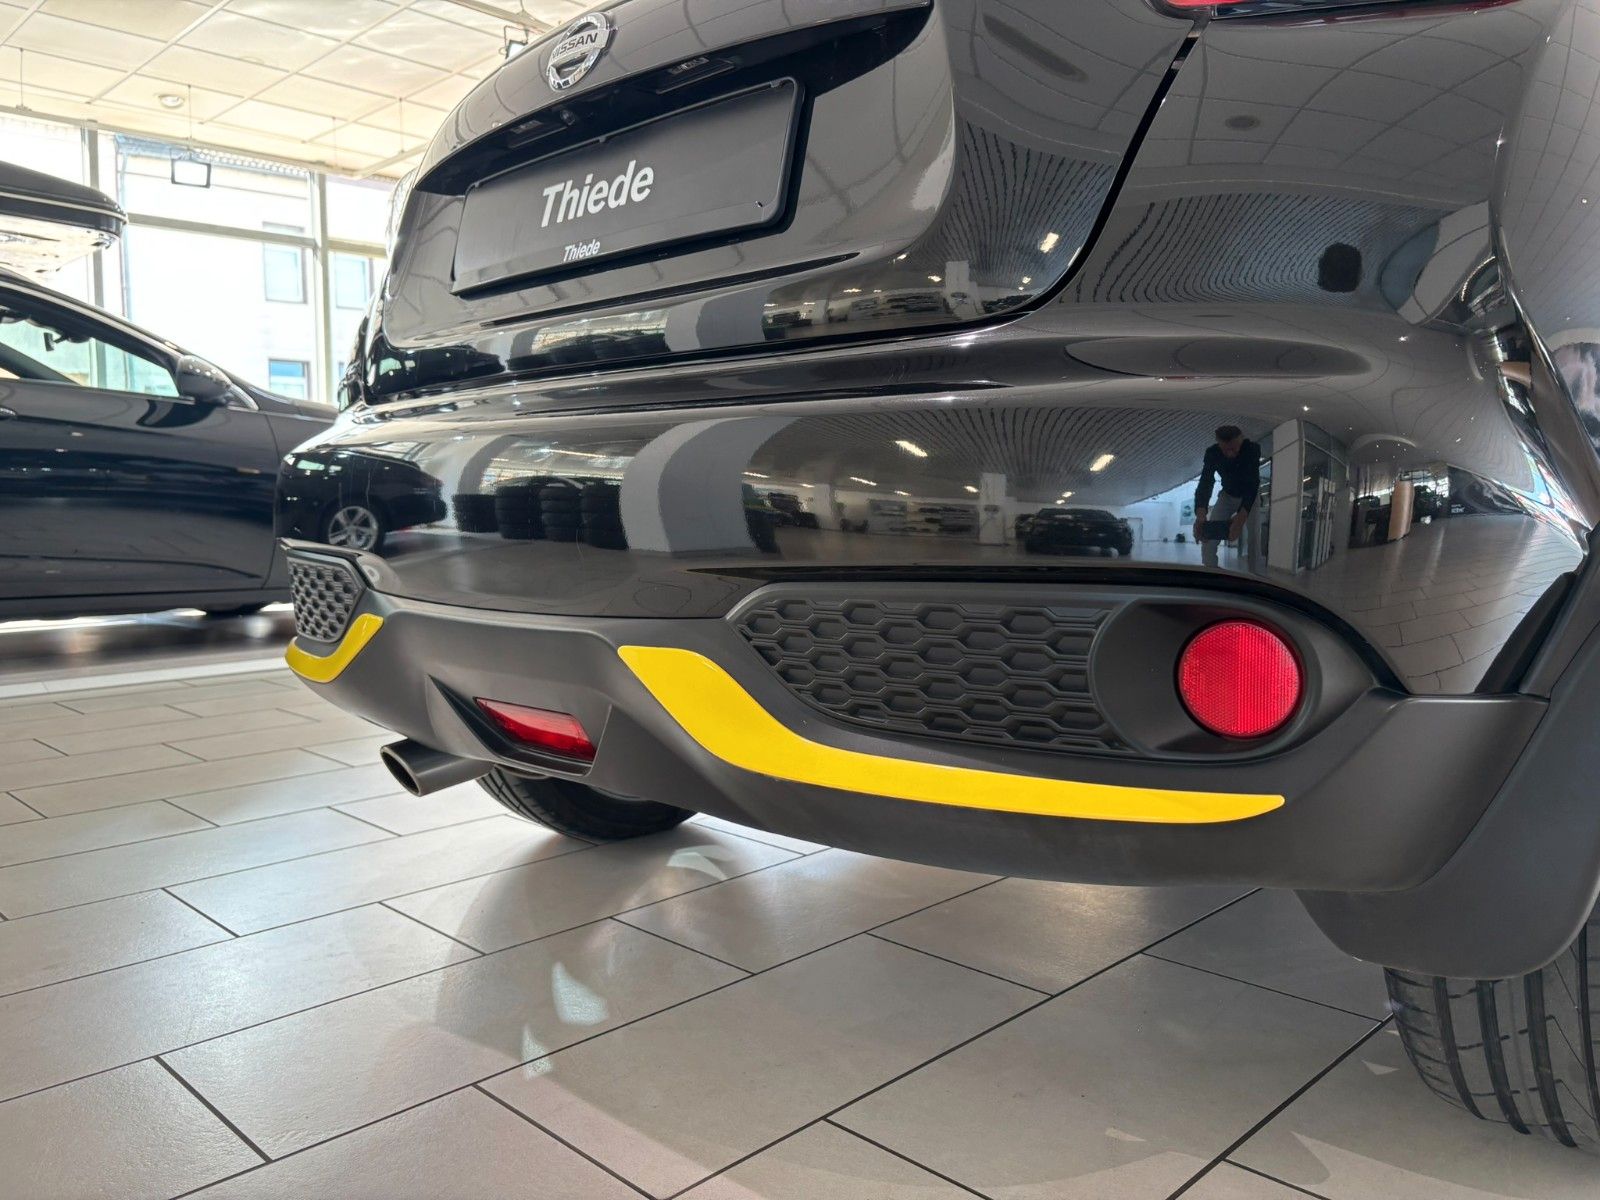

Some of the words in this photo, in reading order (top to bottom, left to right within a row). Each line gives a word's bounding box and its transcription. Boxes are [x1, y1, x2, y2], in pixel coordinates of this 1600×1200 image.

[552, 32, 598, 59] NISSAN
[541, 160, 654, 228] Thiede
[563, 239, 601, 262] Thiede
